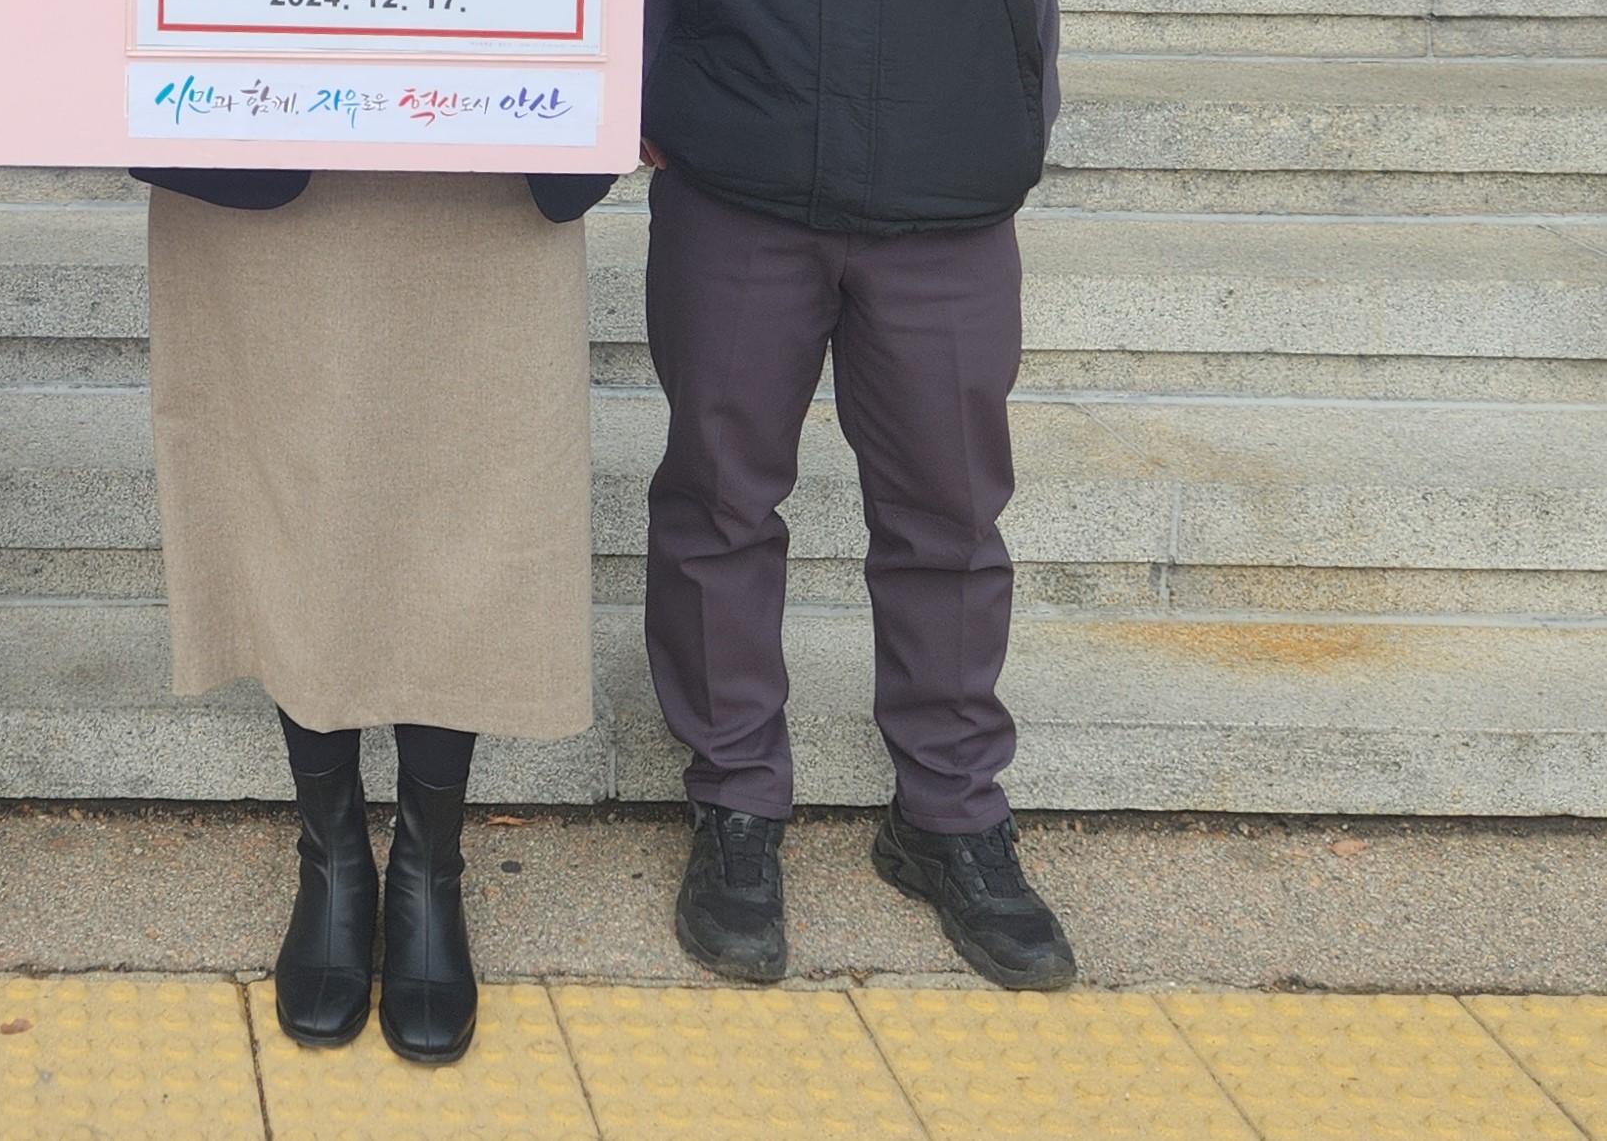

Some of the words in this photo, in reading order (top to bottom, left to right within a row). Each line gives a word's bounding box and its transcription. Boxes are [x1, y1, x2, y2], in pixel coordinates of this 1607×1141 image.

[154, 74, 239, 125] 시민과
[307, 88, 390, 129] 자유로운
[398, 88, 490, 127] 혁신도시
[498, 86, 574, 119] 안산
